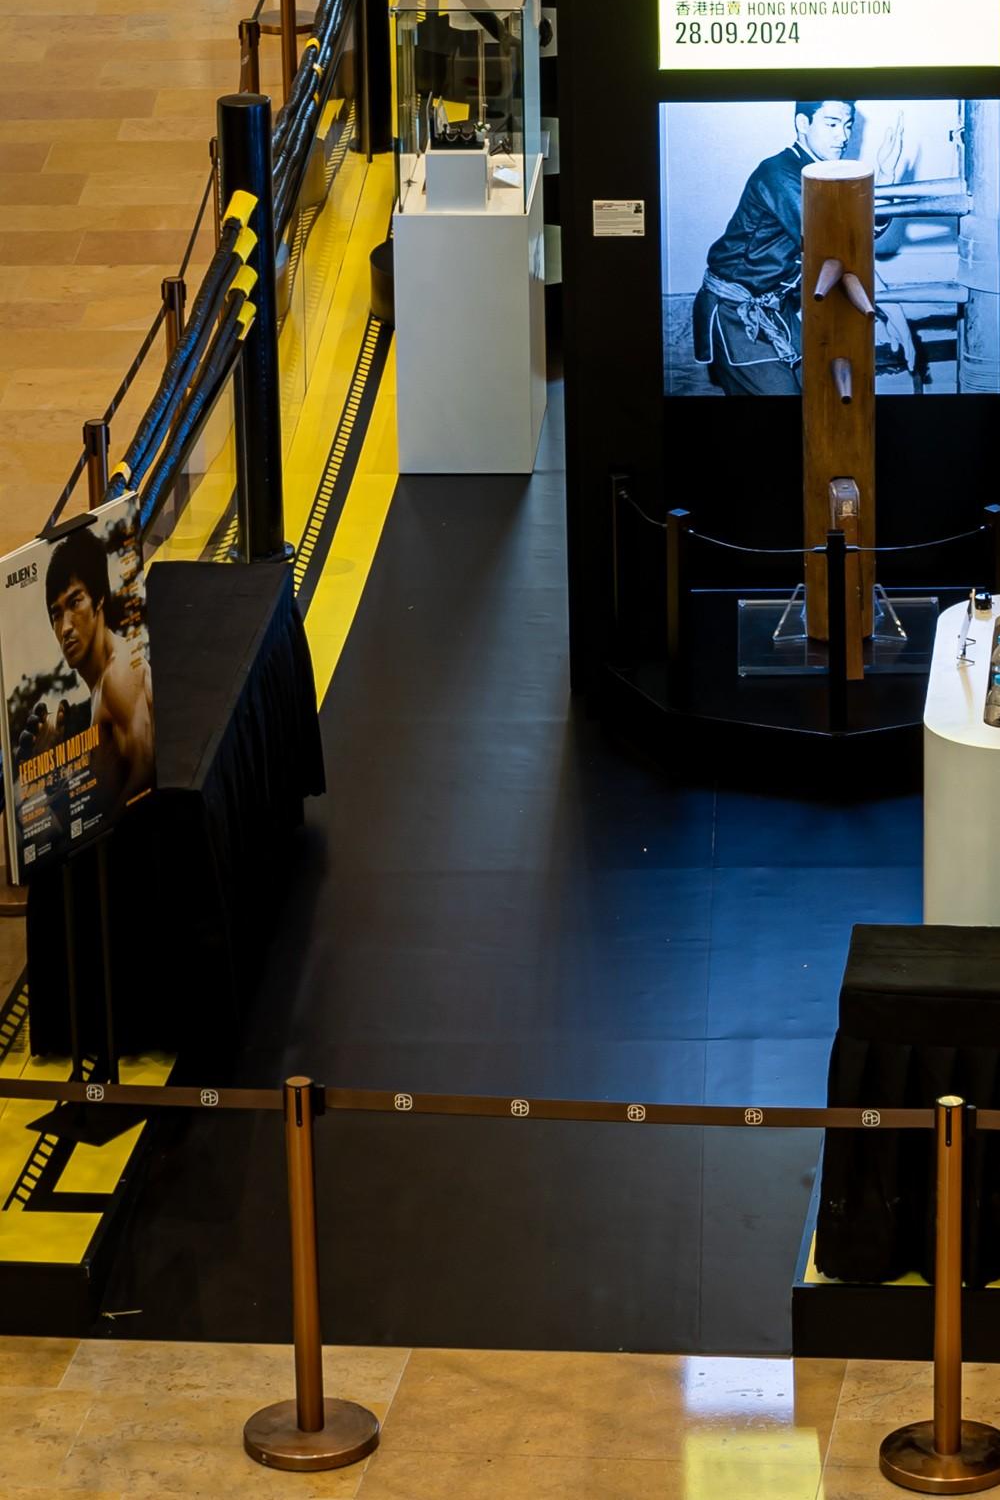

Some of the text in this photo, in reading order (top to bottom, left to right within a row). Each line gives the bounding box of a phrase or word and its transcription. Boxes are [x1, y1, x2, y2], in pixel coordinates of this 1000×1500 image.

[747, 1, 786, 16] HONG
[790, 1, 828, 15] KONG
[832, 0, 892, 15] AUCTION
[676, 21, 801, 45] 28.09.2024
[19, 748, 55, 788] LEGENDS
[55, 742, 66, 768] IN
[66, 723, 100, 761] MOTION
